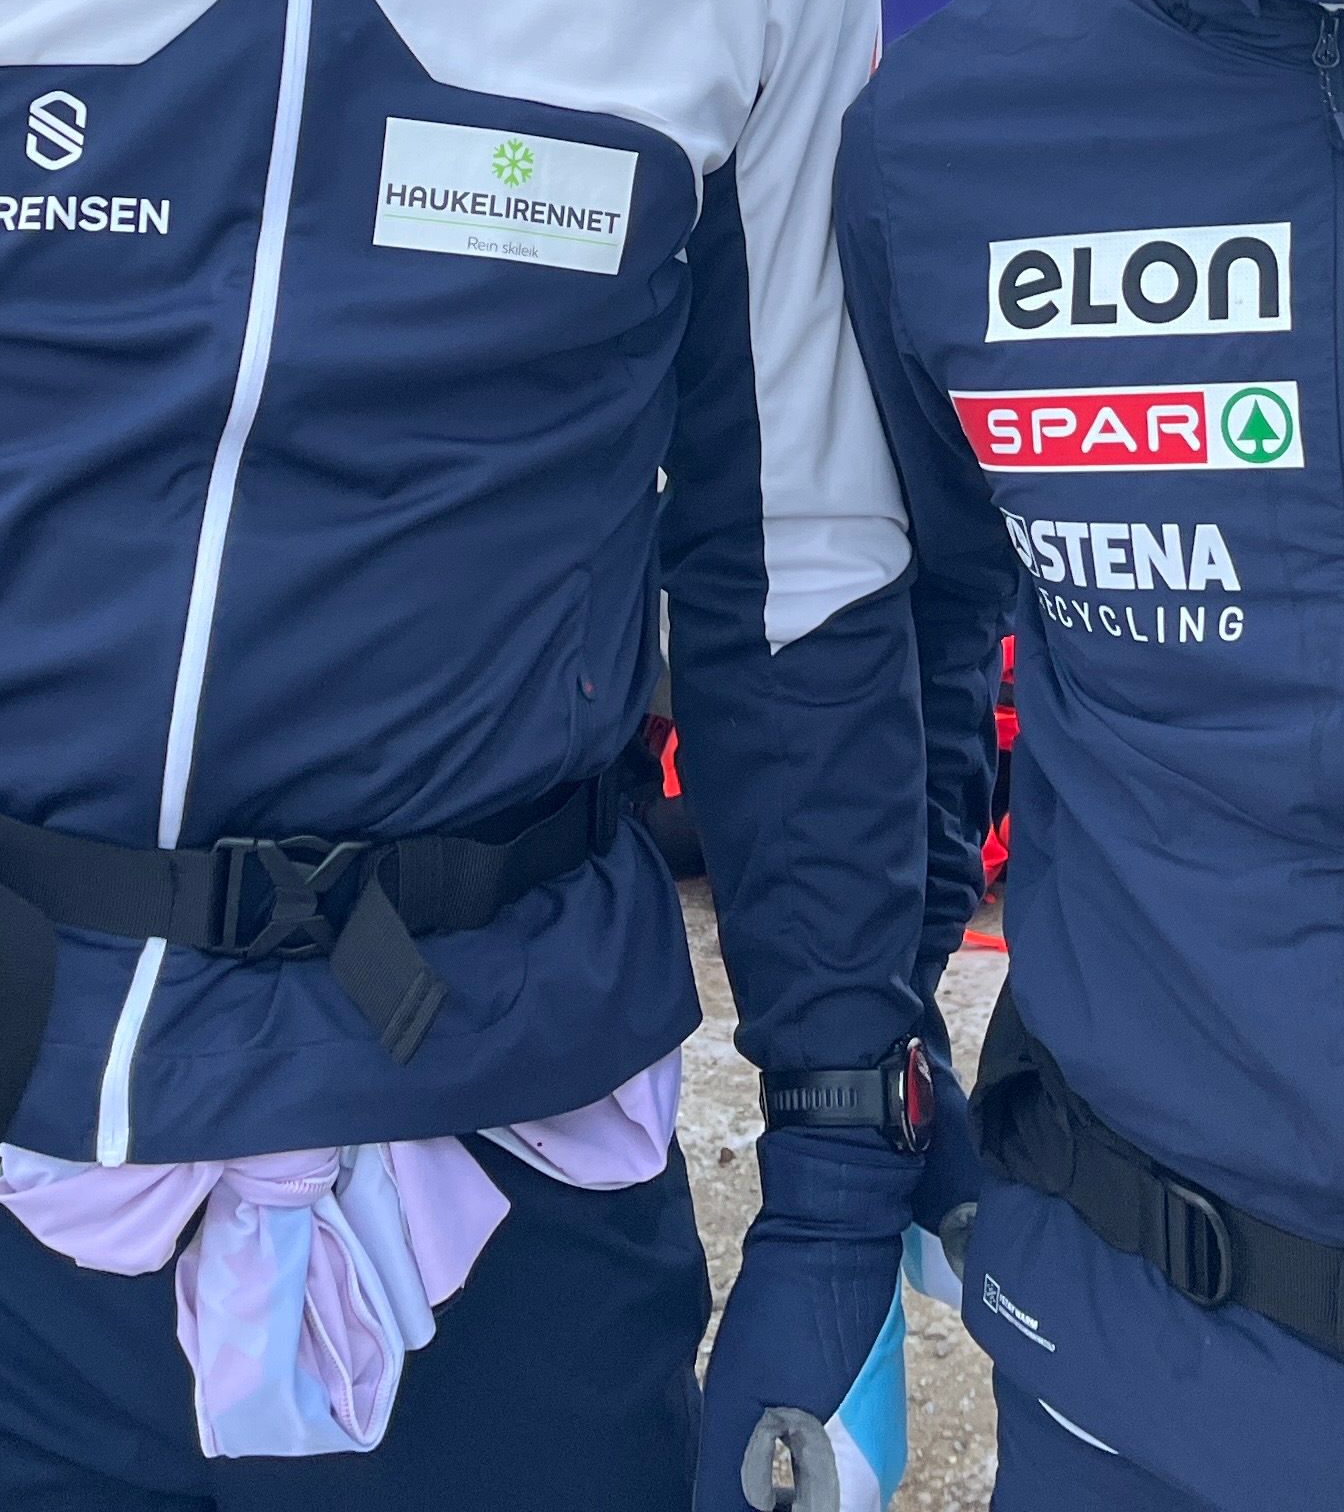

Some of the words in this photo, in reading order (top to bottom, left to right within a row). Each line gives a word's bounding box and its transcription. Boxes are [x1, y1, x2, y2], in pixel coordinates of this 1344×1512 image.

[385, 182, 621, 236] HAUKELIRENNET
[467, 235, 497, 256] Rein
[502, 240, 539, 259] skileik
[987, 404, 1201, 455] SPAR
[1031, 520, 1242, 591] STENA
